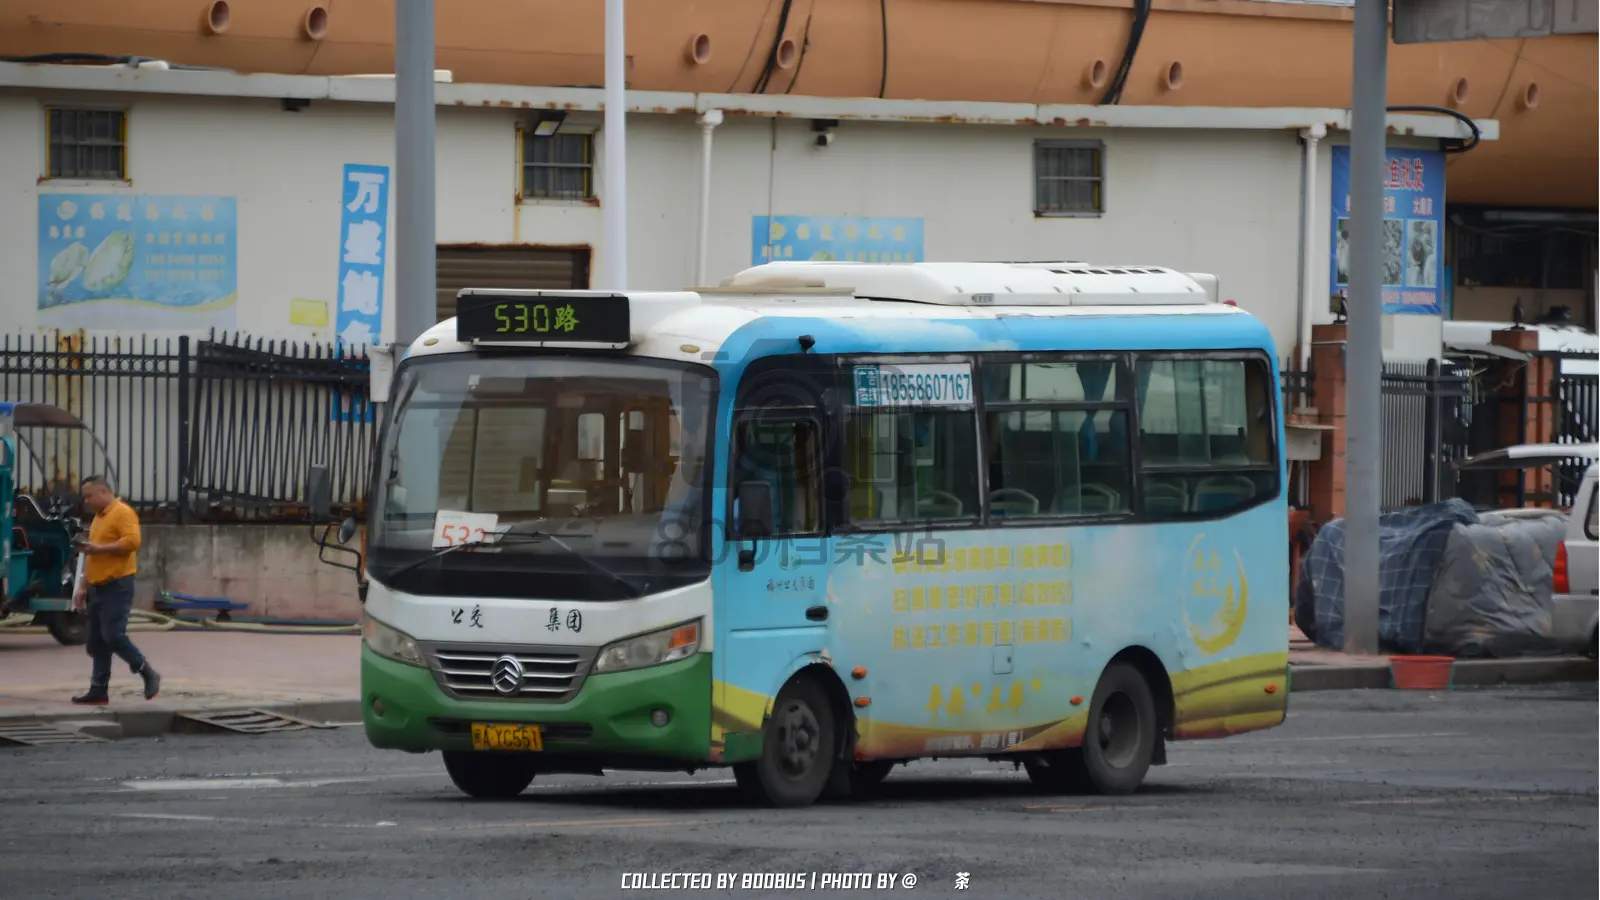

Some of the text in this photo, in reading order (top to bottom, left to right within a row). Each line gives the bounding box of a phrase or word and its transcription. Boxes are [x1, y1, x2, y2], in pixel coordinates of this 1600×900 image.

[495, 304, 580, 332] 530路
[882, 373, 971, 400] 18558607167
[451, 604, 582, 634] 公交 集团
